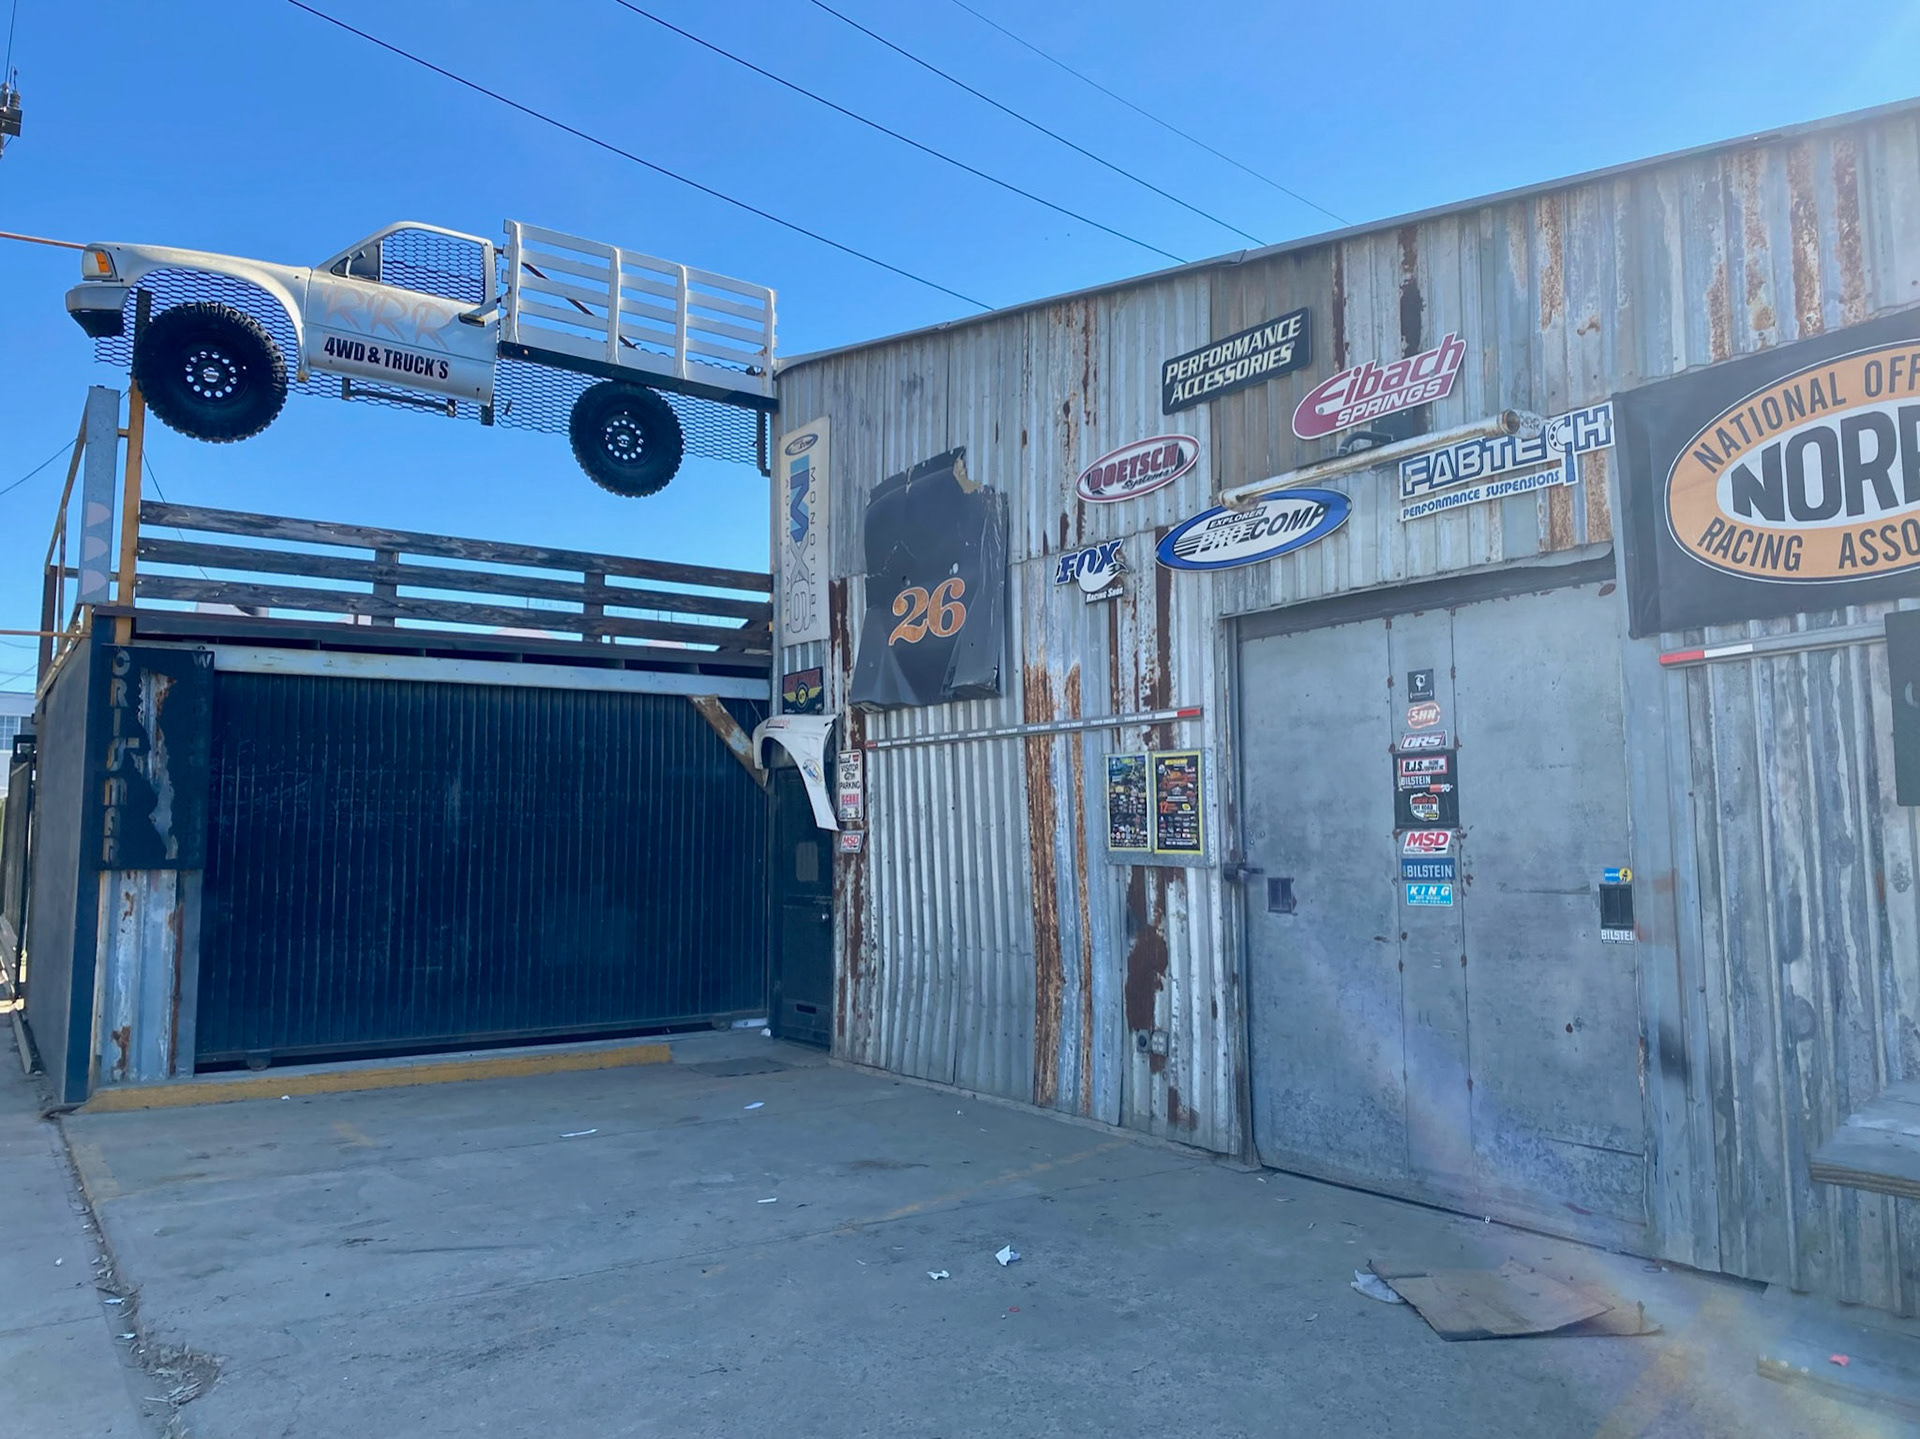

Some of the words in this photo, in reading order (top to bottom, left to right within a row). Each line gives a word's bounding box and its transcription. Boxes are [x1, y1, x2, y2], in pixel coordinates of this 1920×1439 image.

[324, 336, 366, 362] 4WD
[367, 346, 381, 364] &
[1165, 314, 1303, 386] PERFORMANCE
[1169, 344, 1293, 406] ACCESSORIES
[1335, 378, 1442, 427] SPRINGS
[1692, 372, 1847, 474] NATIONAL
[1090, 442, 1180, 491] DOETSCH
[1402, 405, 1613, 497] FABTECH
[1403, 489, 1480, 519] PERFORMANCE
[1485, 470, 1560, 497] SUSPENSIONS
[1209, 507, 1265, 529] EXPLORER
[1249, 502, 1331, 540] COMP
[809, 466, 817, 625] MONOTUBE
[1056, 539, 1124, 584] FOX
[1697, 516, 1803, 571] RACING
[888, 577, 967, 646] 26
[840, 781, 860, 790] PARKING
[841, 763, 859, 773] VISITOR
[1400, 775, 1431, 786] BILSTEIN
[842, 835, 859, 845] MSD
[1407, 832, 1449, 847] MSD
[1407, 865, 1453, 878] BILSTEIN
[1410, 886, 1450, 896] KING
